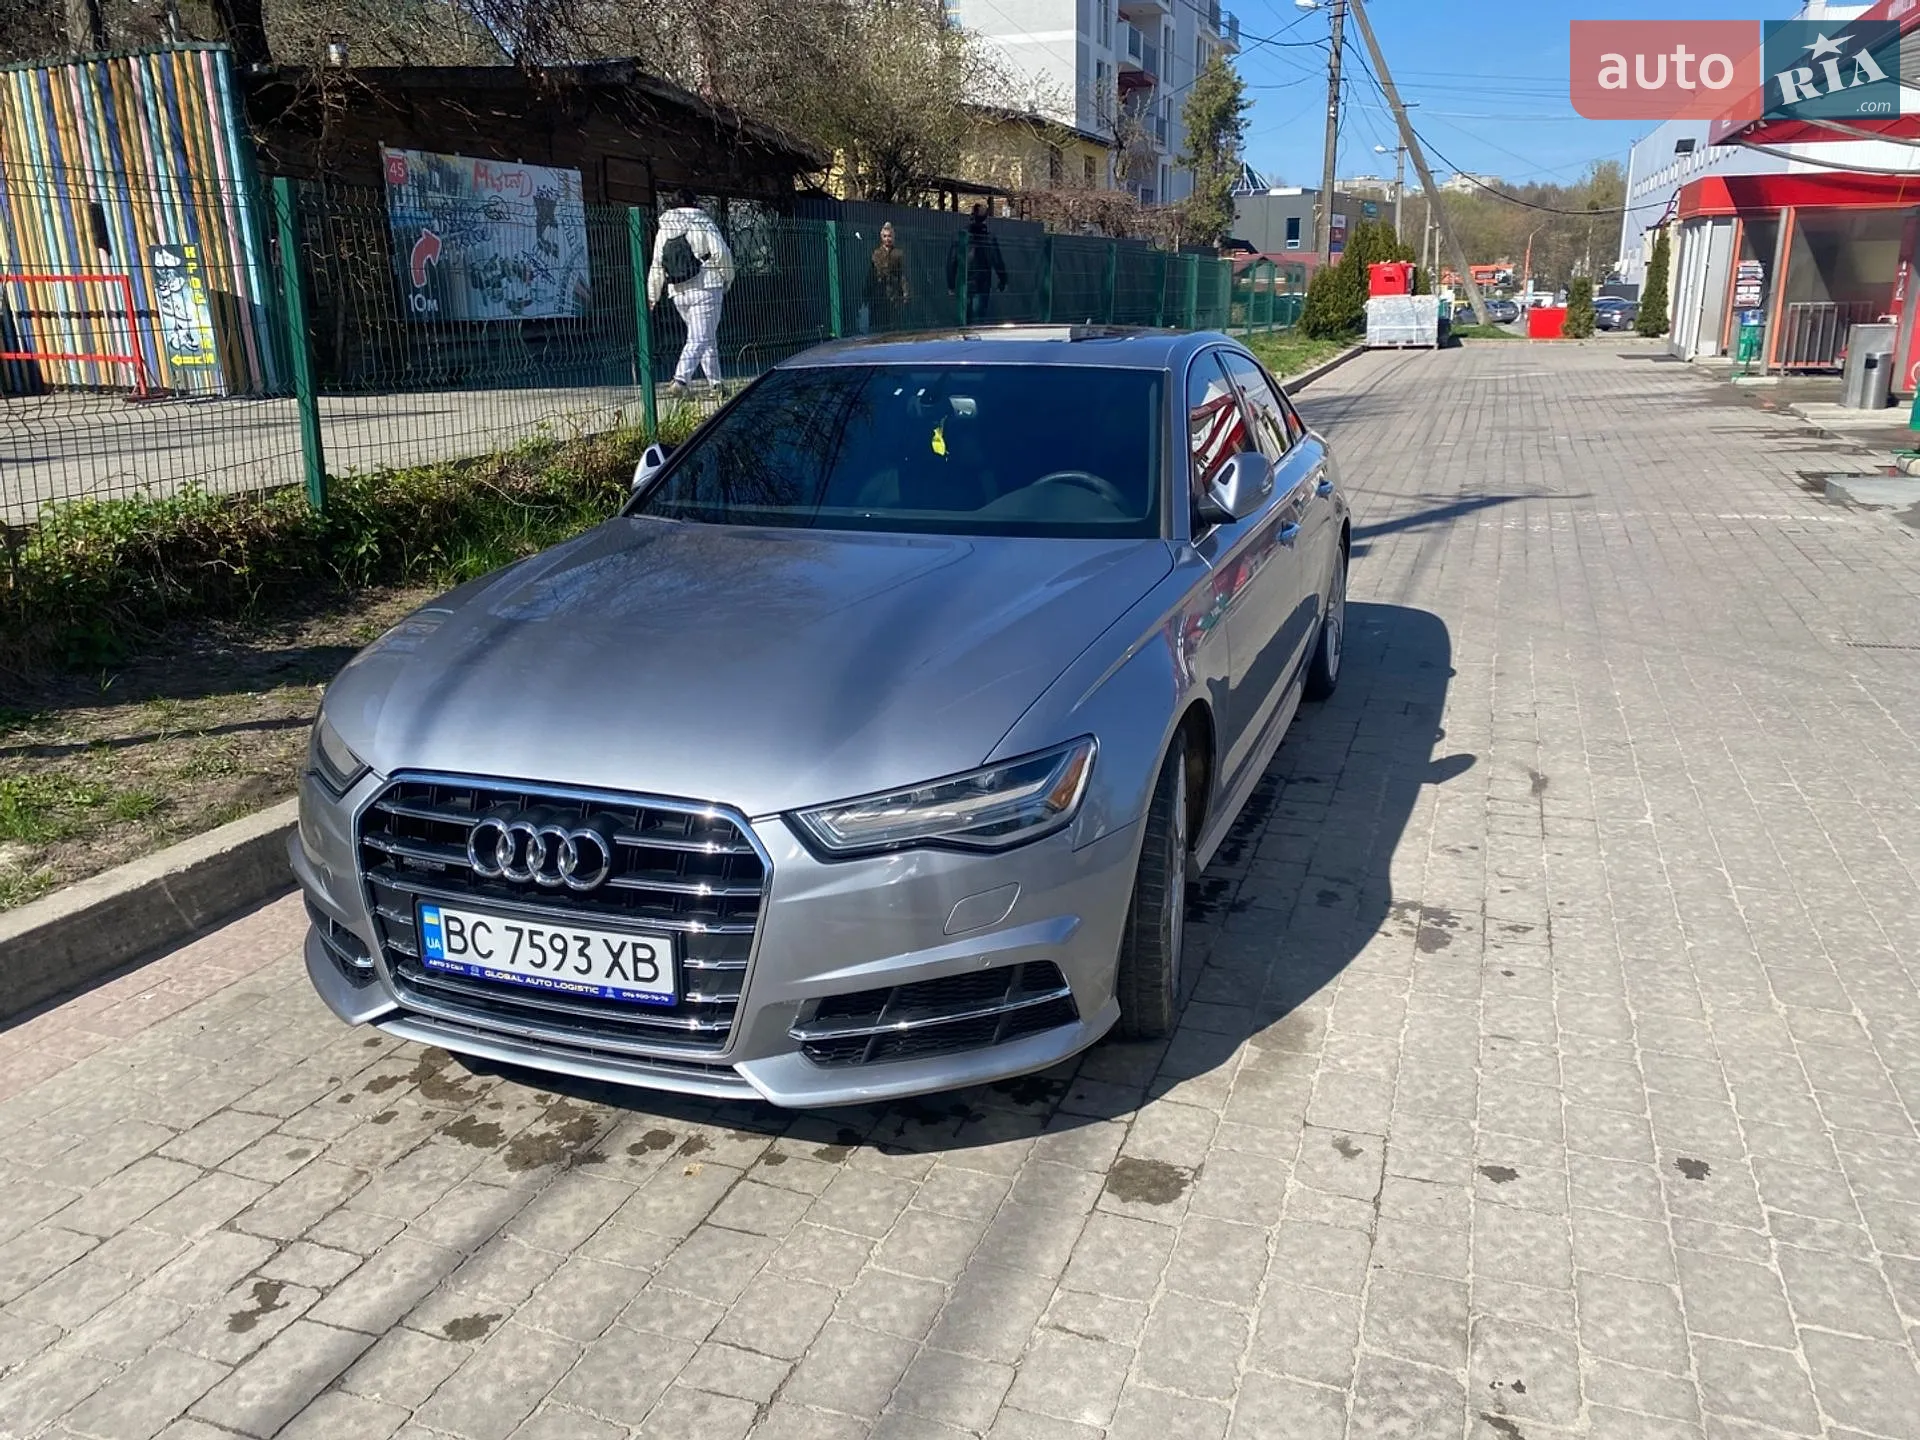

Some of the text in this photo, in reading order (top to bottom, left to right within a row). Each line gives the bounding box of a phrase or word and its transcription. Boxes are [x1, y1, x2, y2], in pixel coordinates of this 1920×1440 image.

[389, 161, 405, 178] 45
[427, 938, 442, 950] UA
[444, 914, 660, 984] BC 7593 XB
[484, 970, 600, 994] GLOBAL AUTO LOGISTIC
